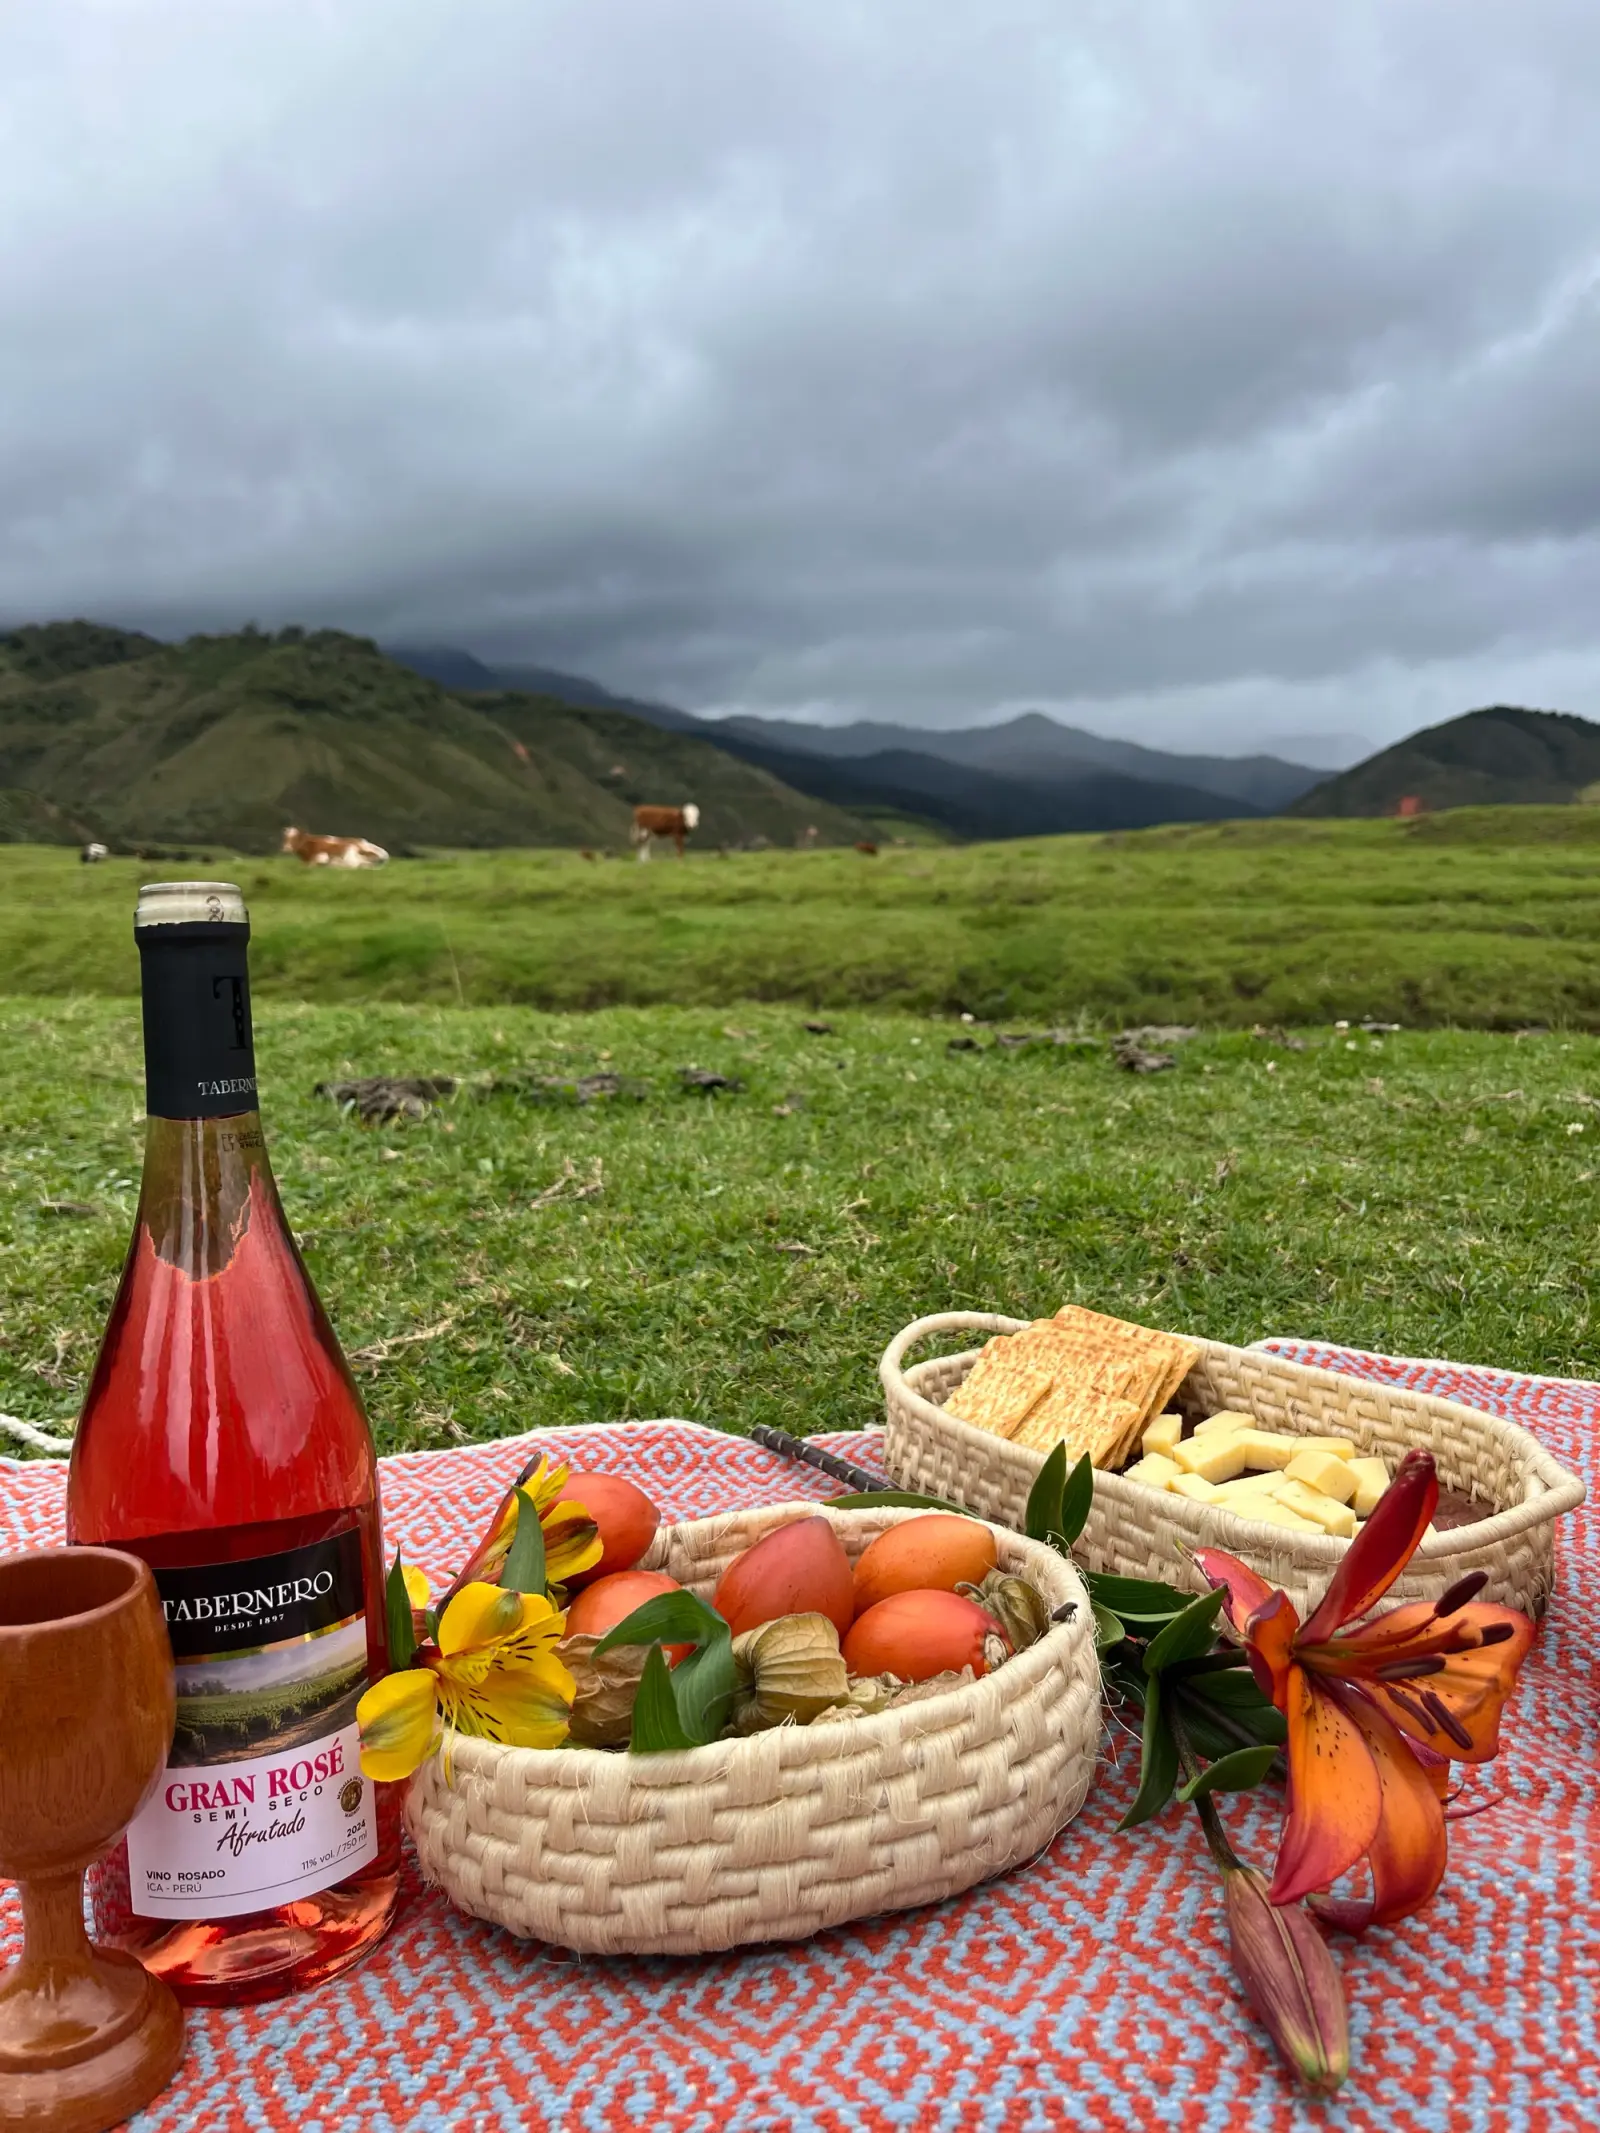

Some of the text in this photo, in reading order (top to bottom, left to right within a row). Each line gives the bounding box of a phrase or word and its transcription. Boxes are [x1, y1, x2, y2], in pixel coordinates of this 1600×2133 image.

[162, 1570, 333, 1623] TABERNERO
[214, 1613, 285, 1633] DESDE 1897
[164, 1736, 346, 1813] GRAN ROSÉ
[193, 1806, 248, 1824] SEMI
[268, 1784, 323, 1812] SECO
[216, 1807, 306, 1858] Afrutado
[346, 1819, 366, 1838] 2024
[301, 1857, 318, 1871] 11%
[342, 1837, 358, 1853] 750
[358, 1829, 368, 1843] ml
[146, 1869, 226, 1881] VINO ROSADO
[146, 1882, 164, 1893] ICA
[172, 1882, 202, 1893] PERÚ
